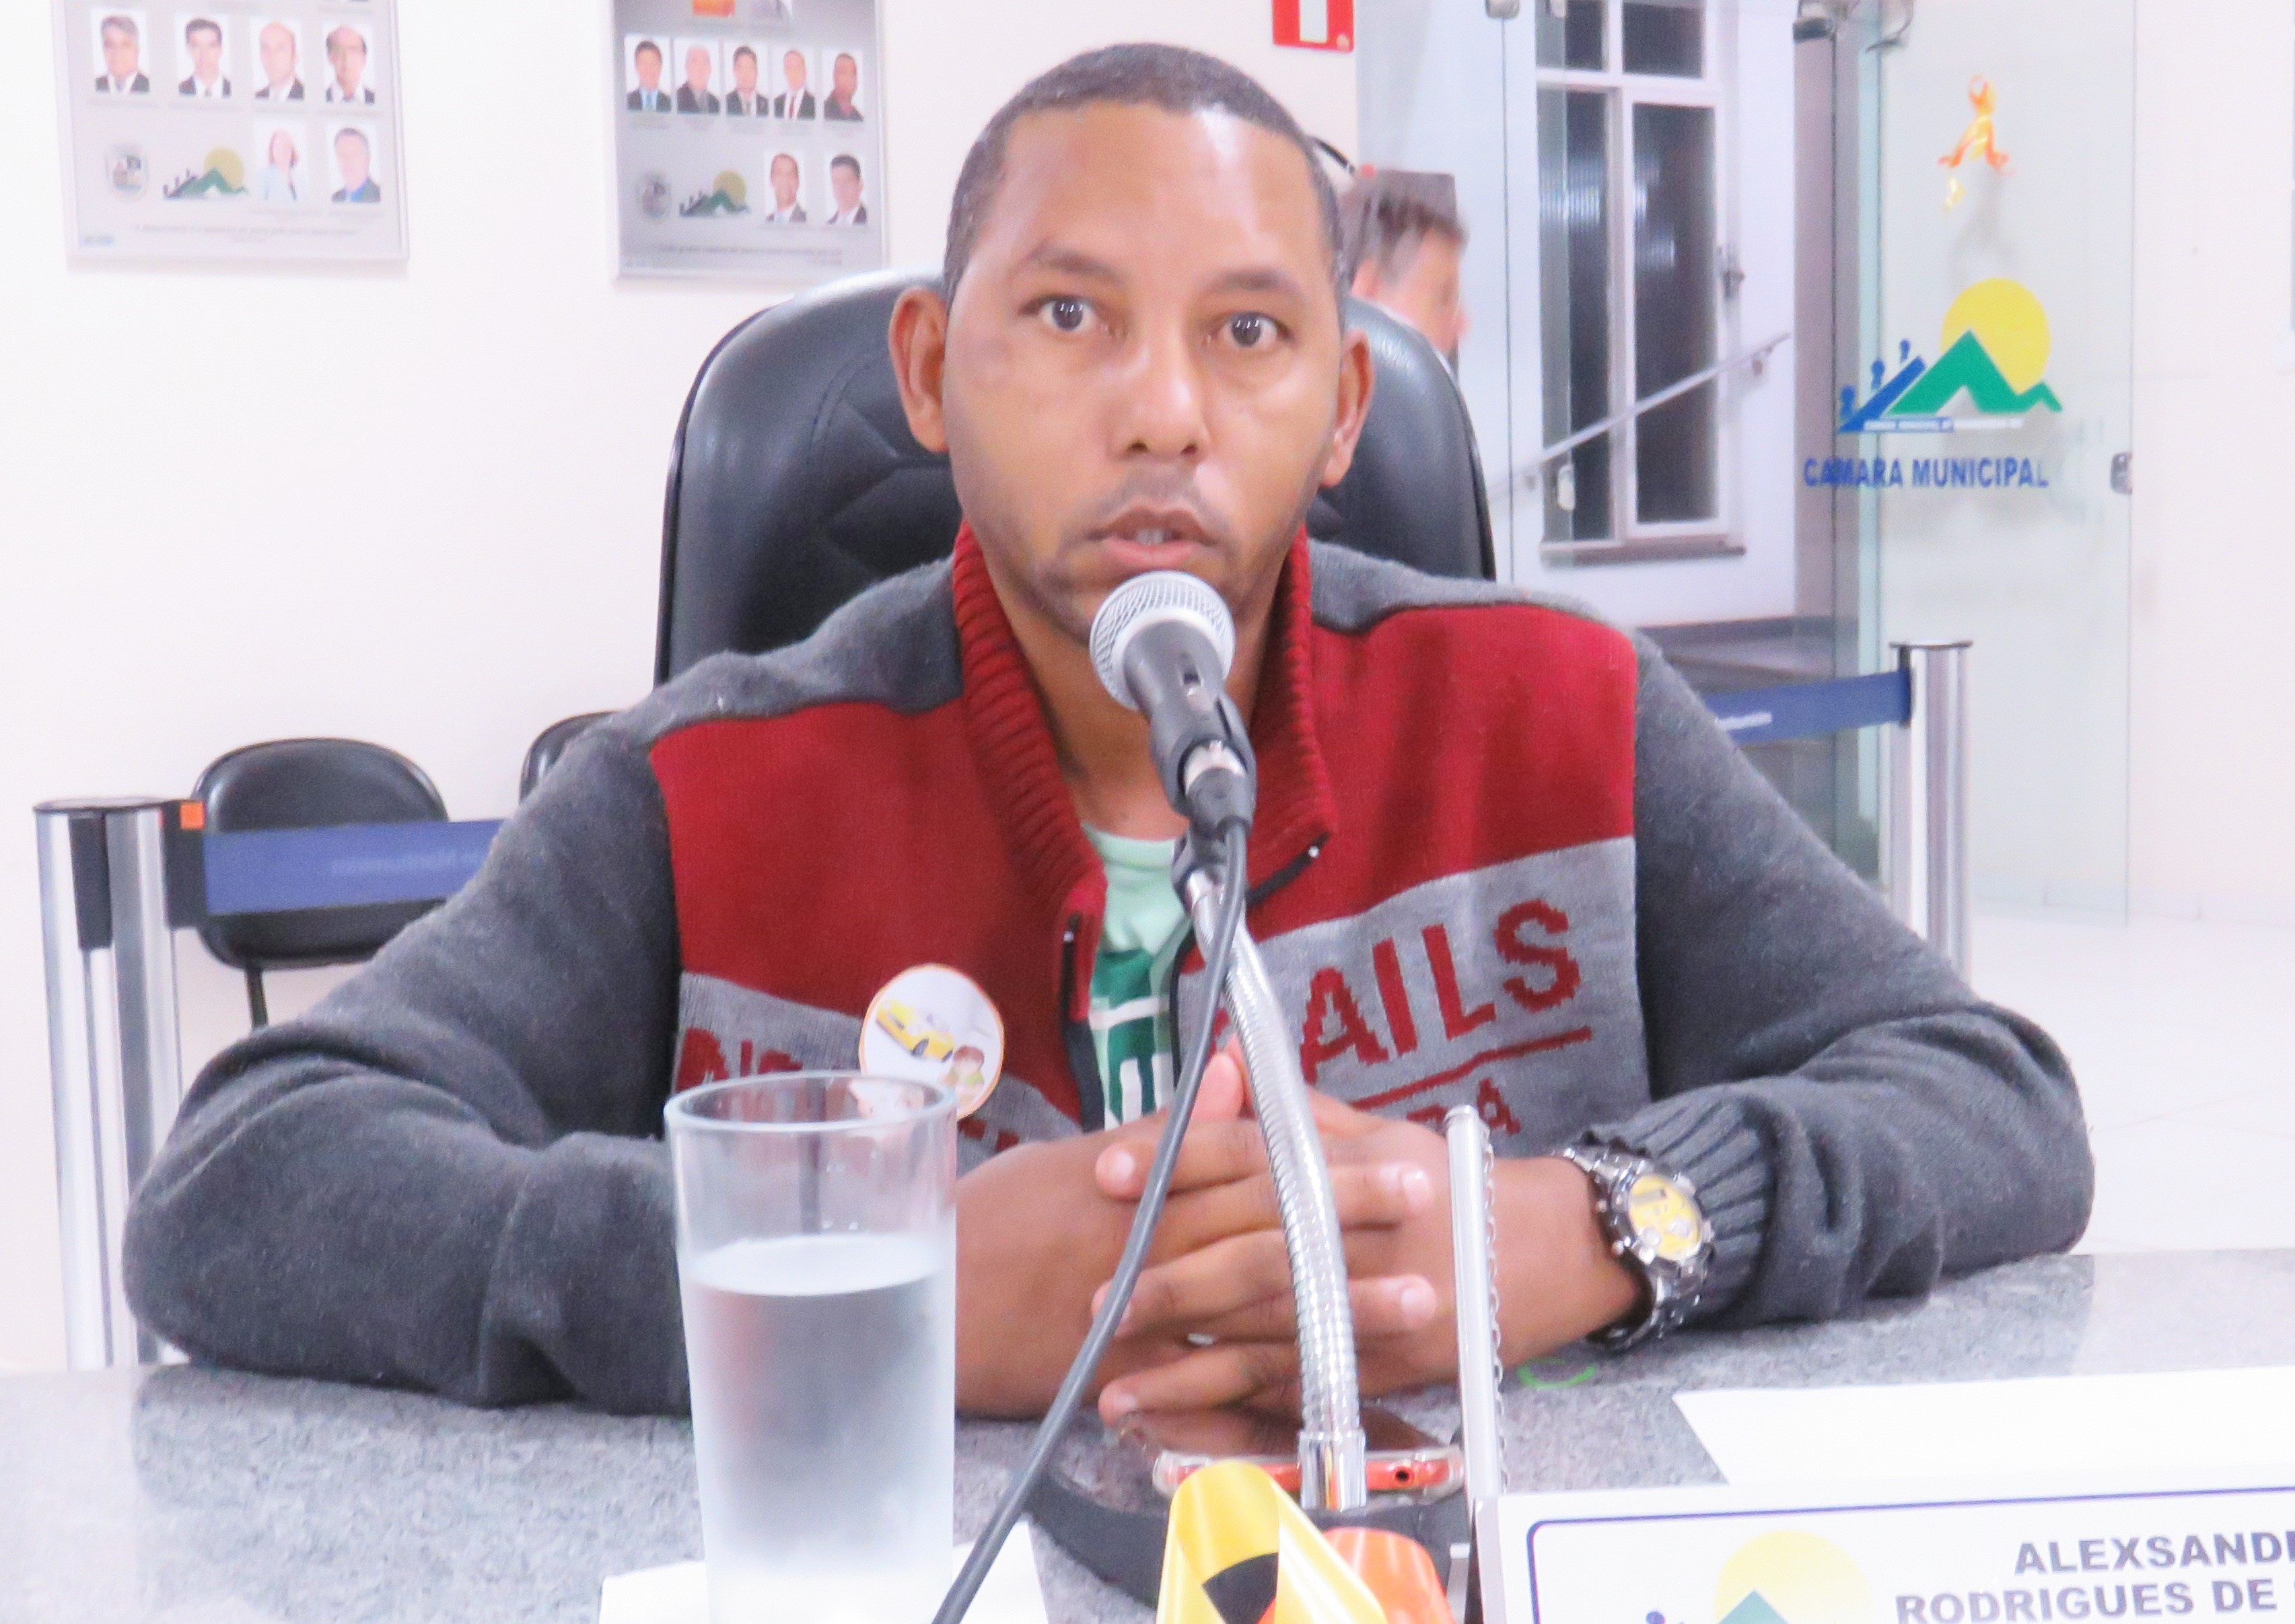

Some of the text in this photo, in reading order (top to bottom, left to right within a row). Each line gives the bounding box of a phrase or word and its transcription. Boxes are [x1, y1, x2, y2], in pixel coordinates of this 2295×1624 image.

[1912, 456, 2049, 489] MUNICIPAL
[1209, 898, 1581, 1085] AILS
[2014, 1530, 2295, 1575] ALEXSAND
[1895, 1581, 2195, 1624] RODRIGUES
[2211, 1577, 2278, 1614] DE
